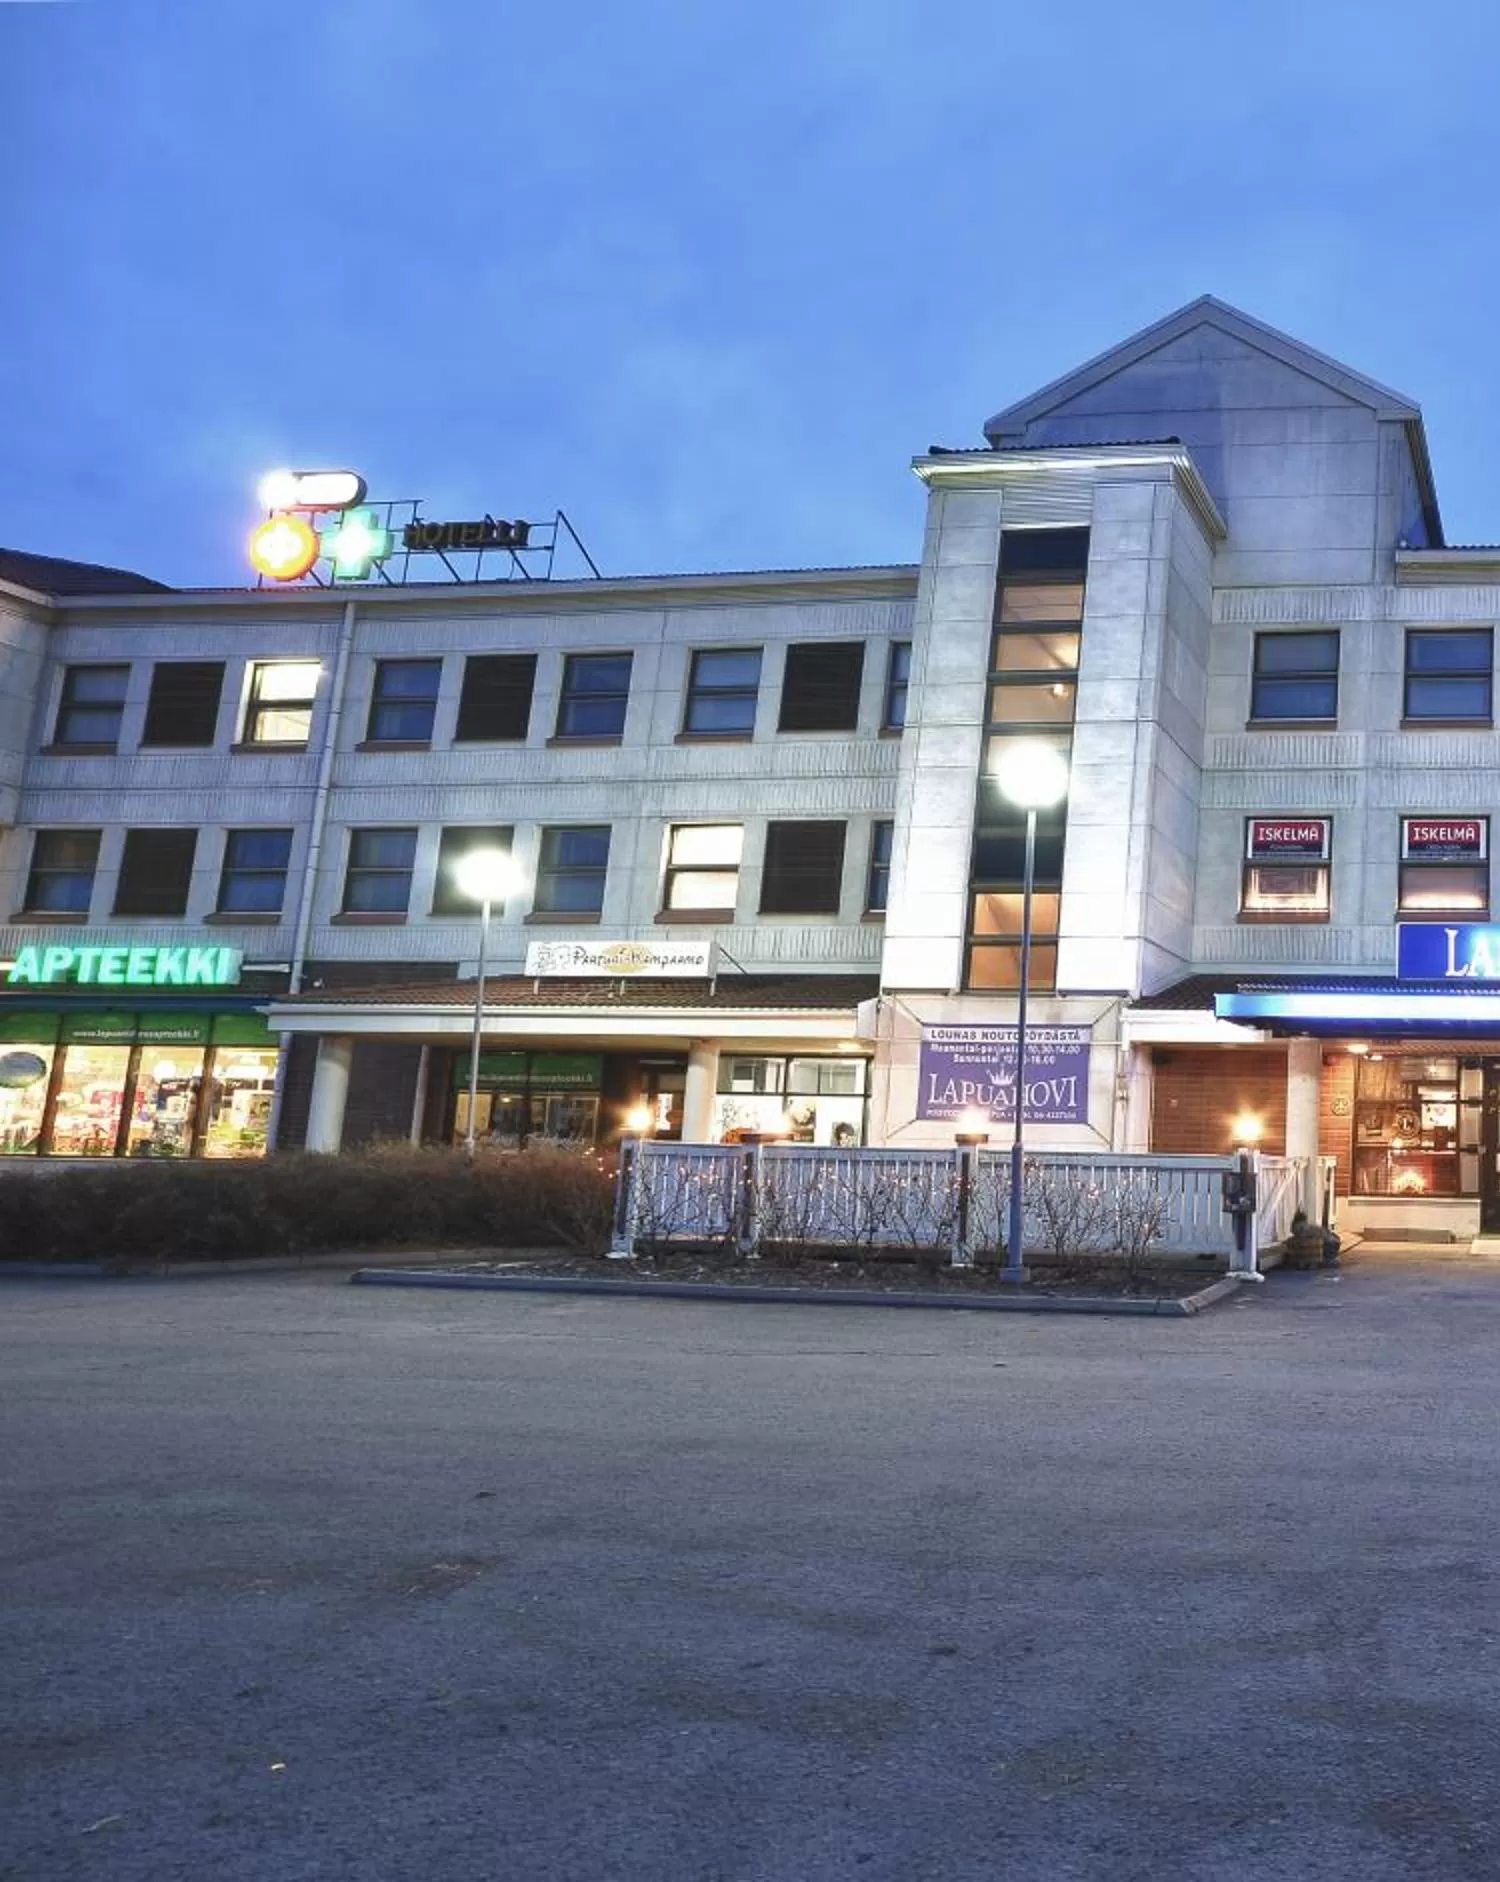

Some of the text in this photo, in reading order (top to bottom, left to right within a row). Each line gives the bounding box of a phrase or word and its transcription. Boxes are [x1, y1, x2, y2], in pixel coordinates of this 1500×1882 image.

[8, 946, 236, 984] APTEEKKI
[930, 1029, 977, 1041] LOUNAS
[927, 1073, 1077, 1109] LAPUAHOVI
